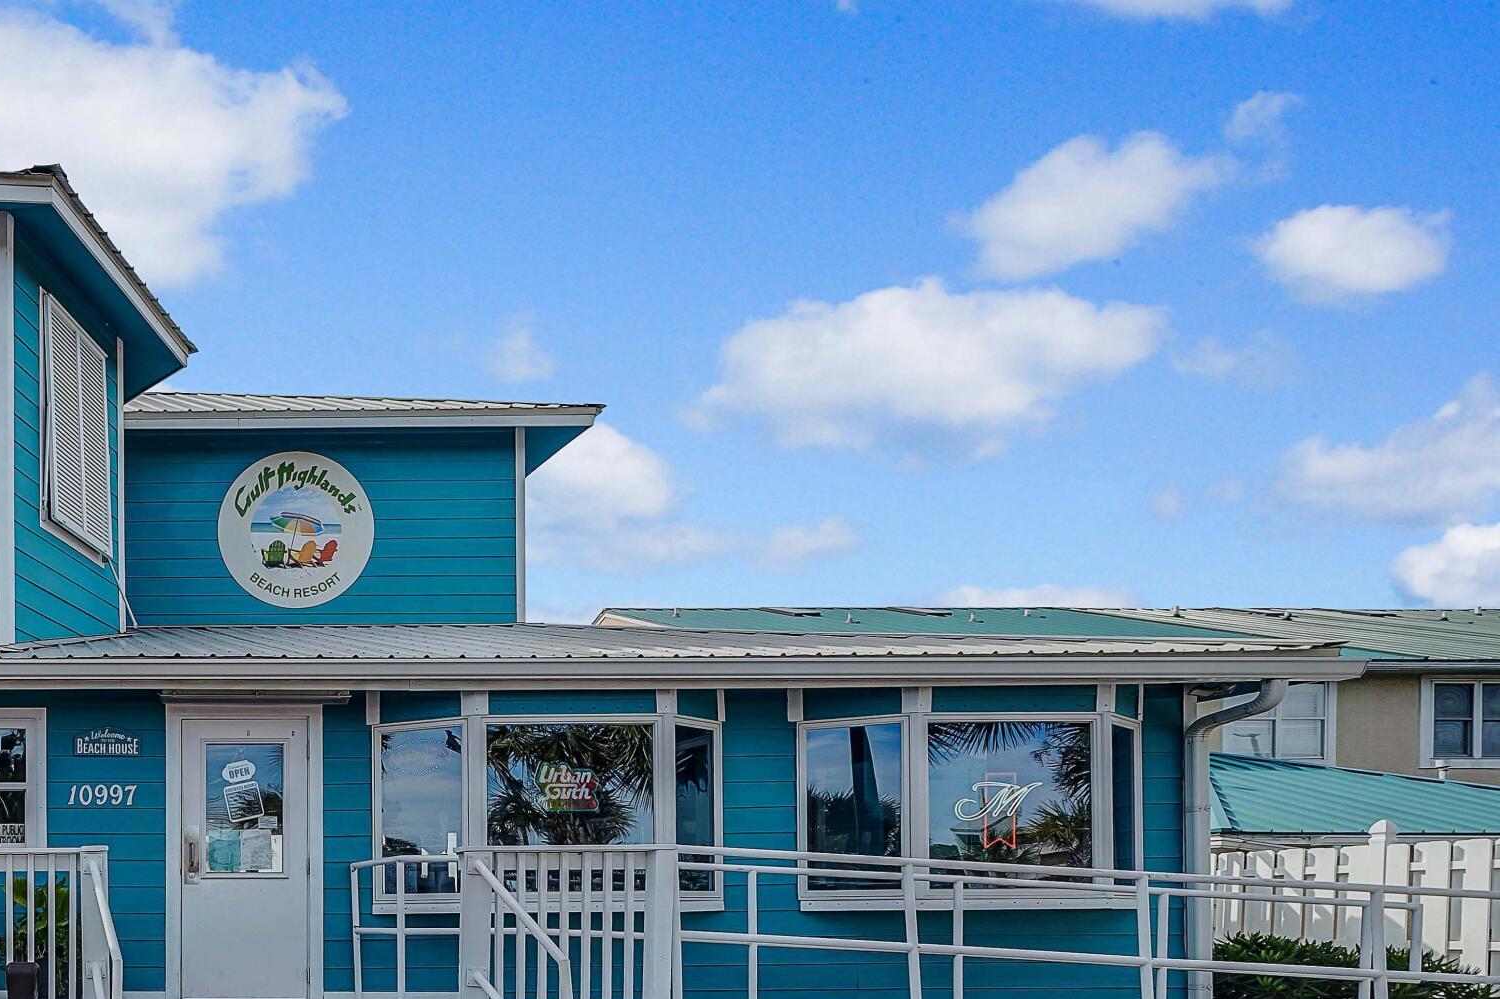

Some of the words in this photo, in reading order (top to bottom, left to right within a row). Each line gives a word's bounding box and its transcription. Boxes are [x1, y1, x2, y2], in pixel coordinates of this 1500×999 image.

[235, 466, 276, 518] Gulf
[277, 461, 357, 514] Highlands
[249, 572, 290, 598] BEACH
[294, 572, 341, 598] RESORT
[91, 729, 126, 740] Welcome
[77, 738, 106, 754] BEACH
[108, 738, 139, 754] HOUSE
[229, 767, 250, 778] OPEN
[540, 764, 592, 783] Urban
[67, 784, 138, 806] 10997
[543, 783, 592, 800] South
[2, 824, 24, 836] PUBLIC
